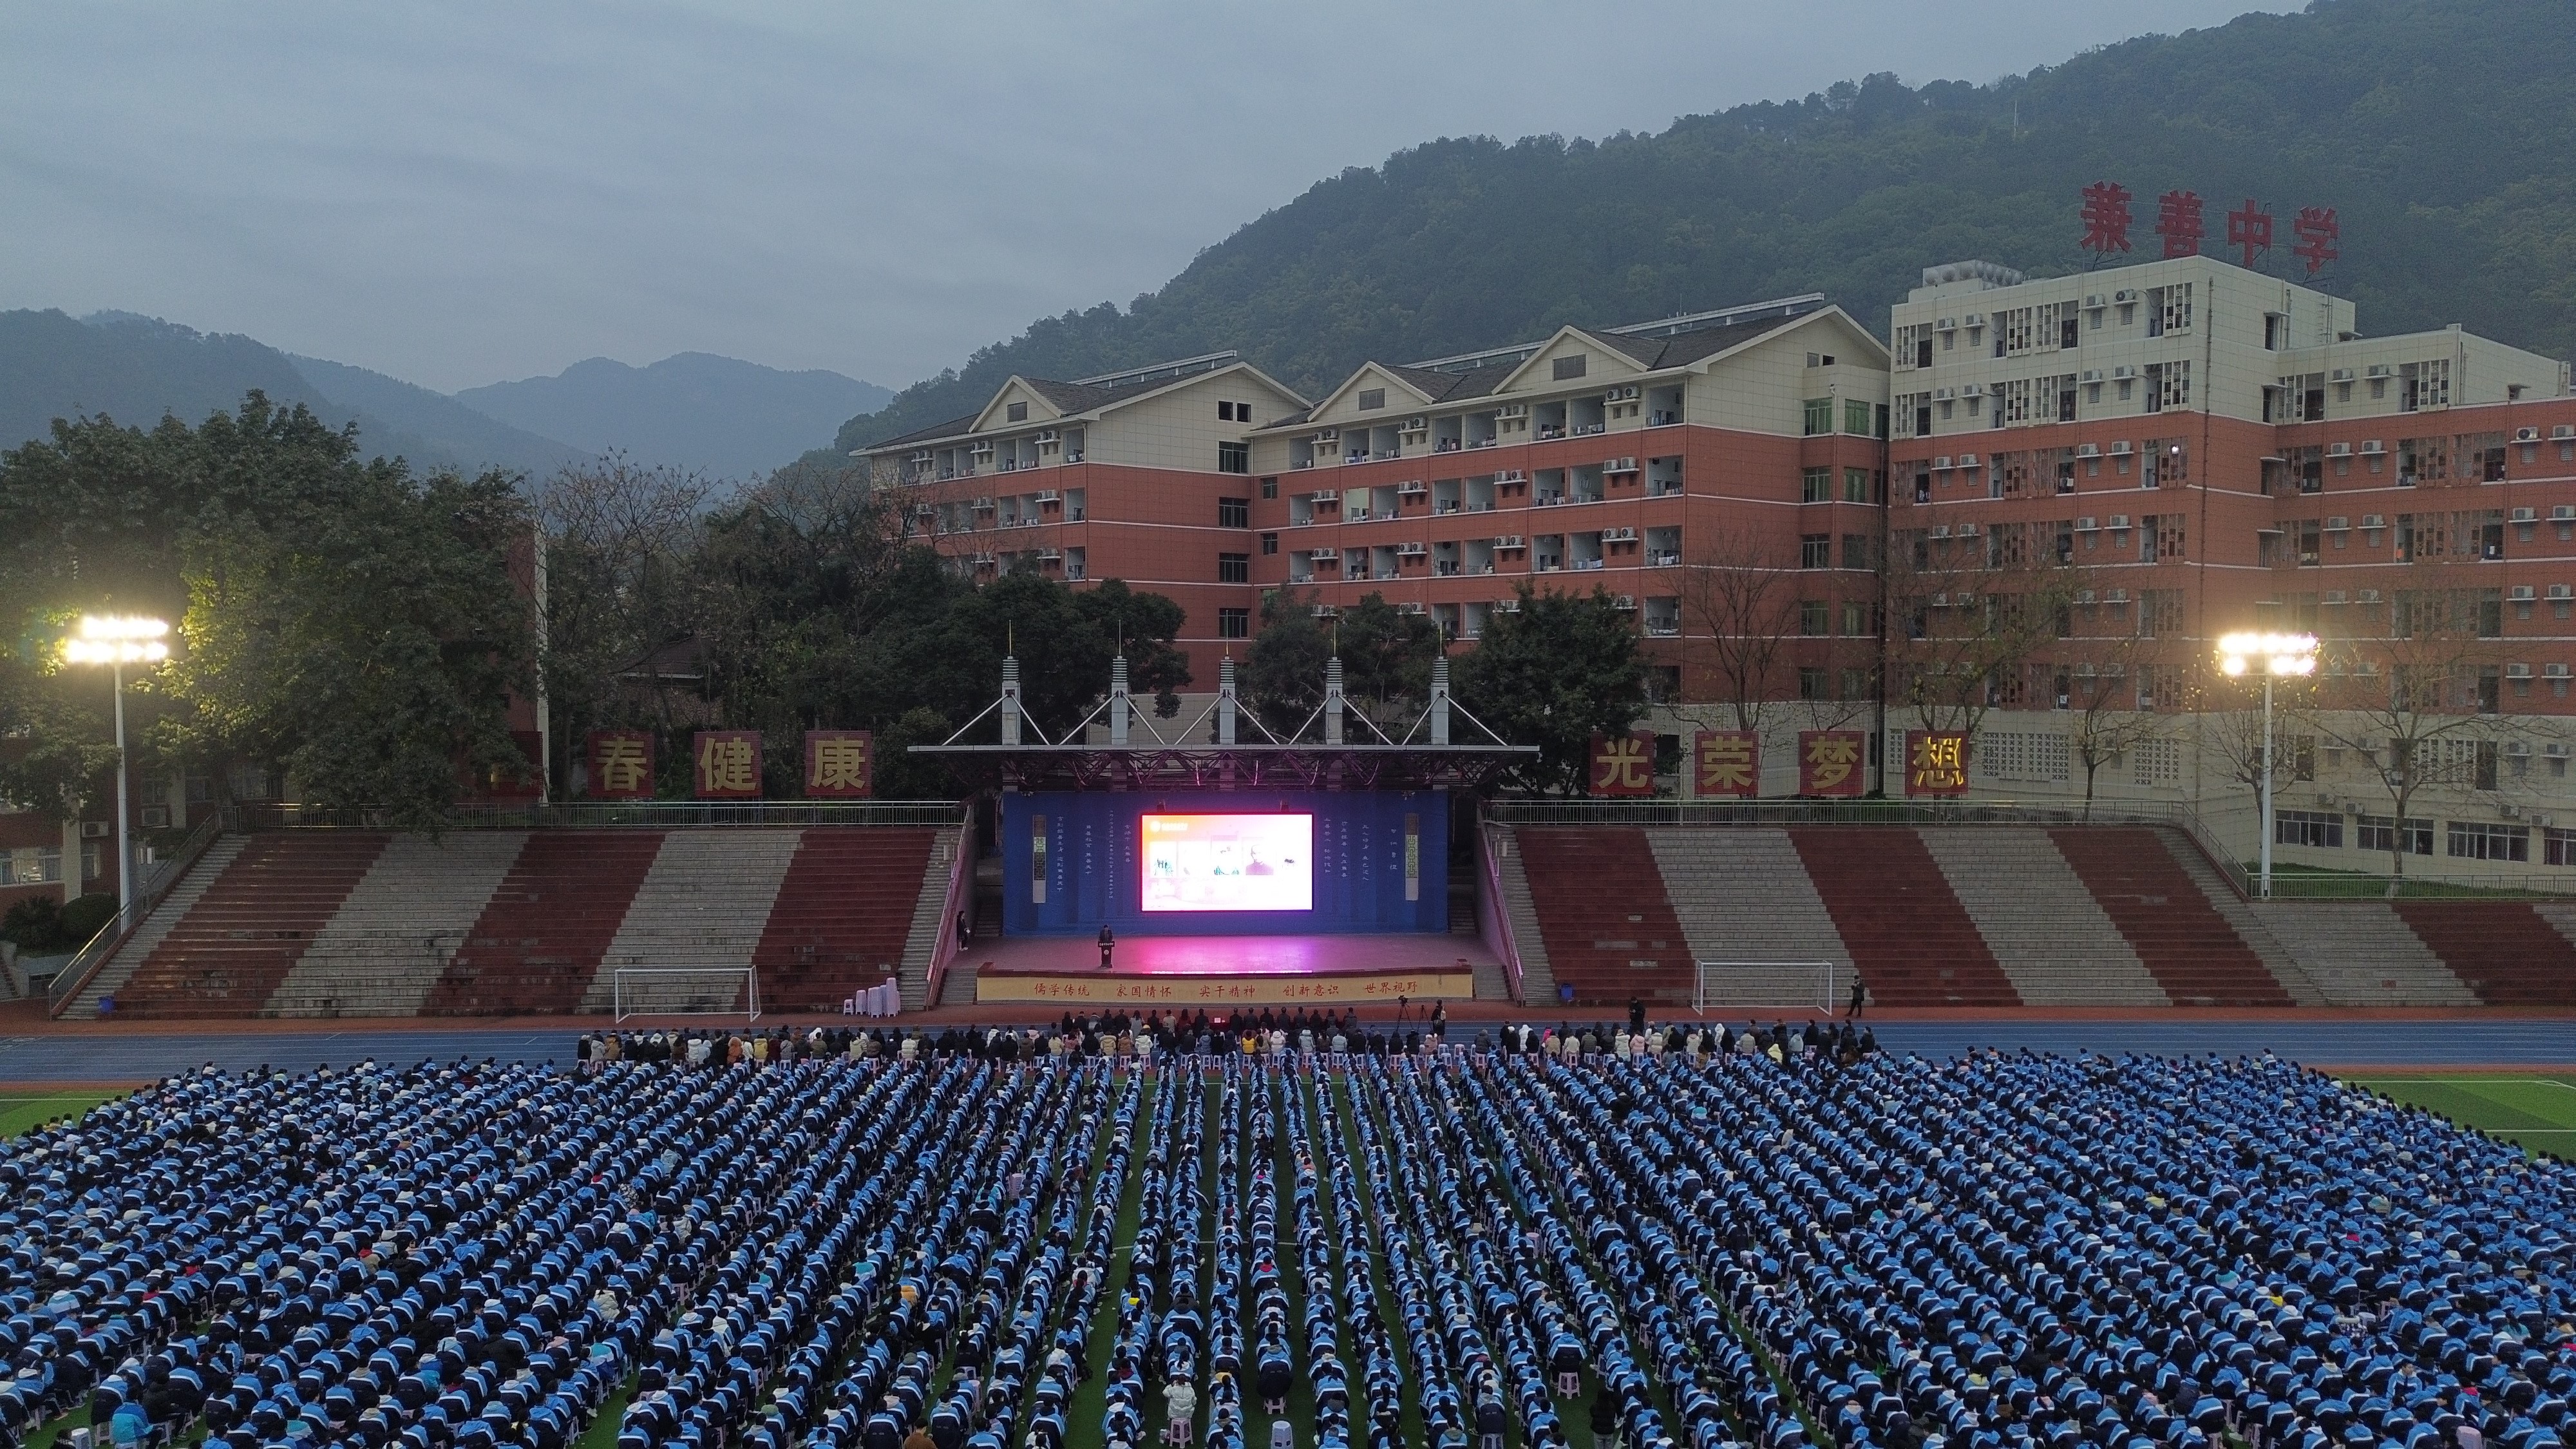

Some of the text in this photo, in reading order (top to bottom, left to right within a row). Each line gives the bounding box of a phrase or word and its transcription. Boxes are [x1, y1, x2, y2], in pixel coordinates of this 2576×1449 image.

[2080, 180, 2338, 273] 兼善中学
[491, 734, 867, 791] 春健康
[1595, 734, 1965, 790] 光荣梦想
[1034, 981, 1417, 998] 儒学传统 家国情怀 实干精神 创新意识 世界视野
